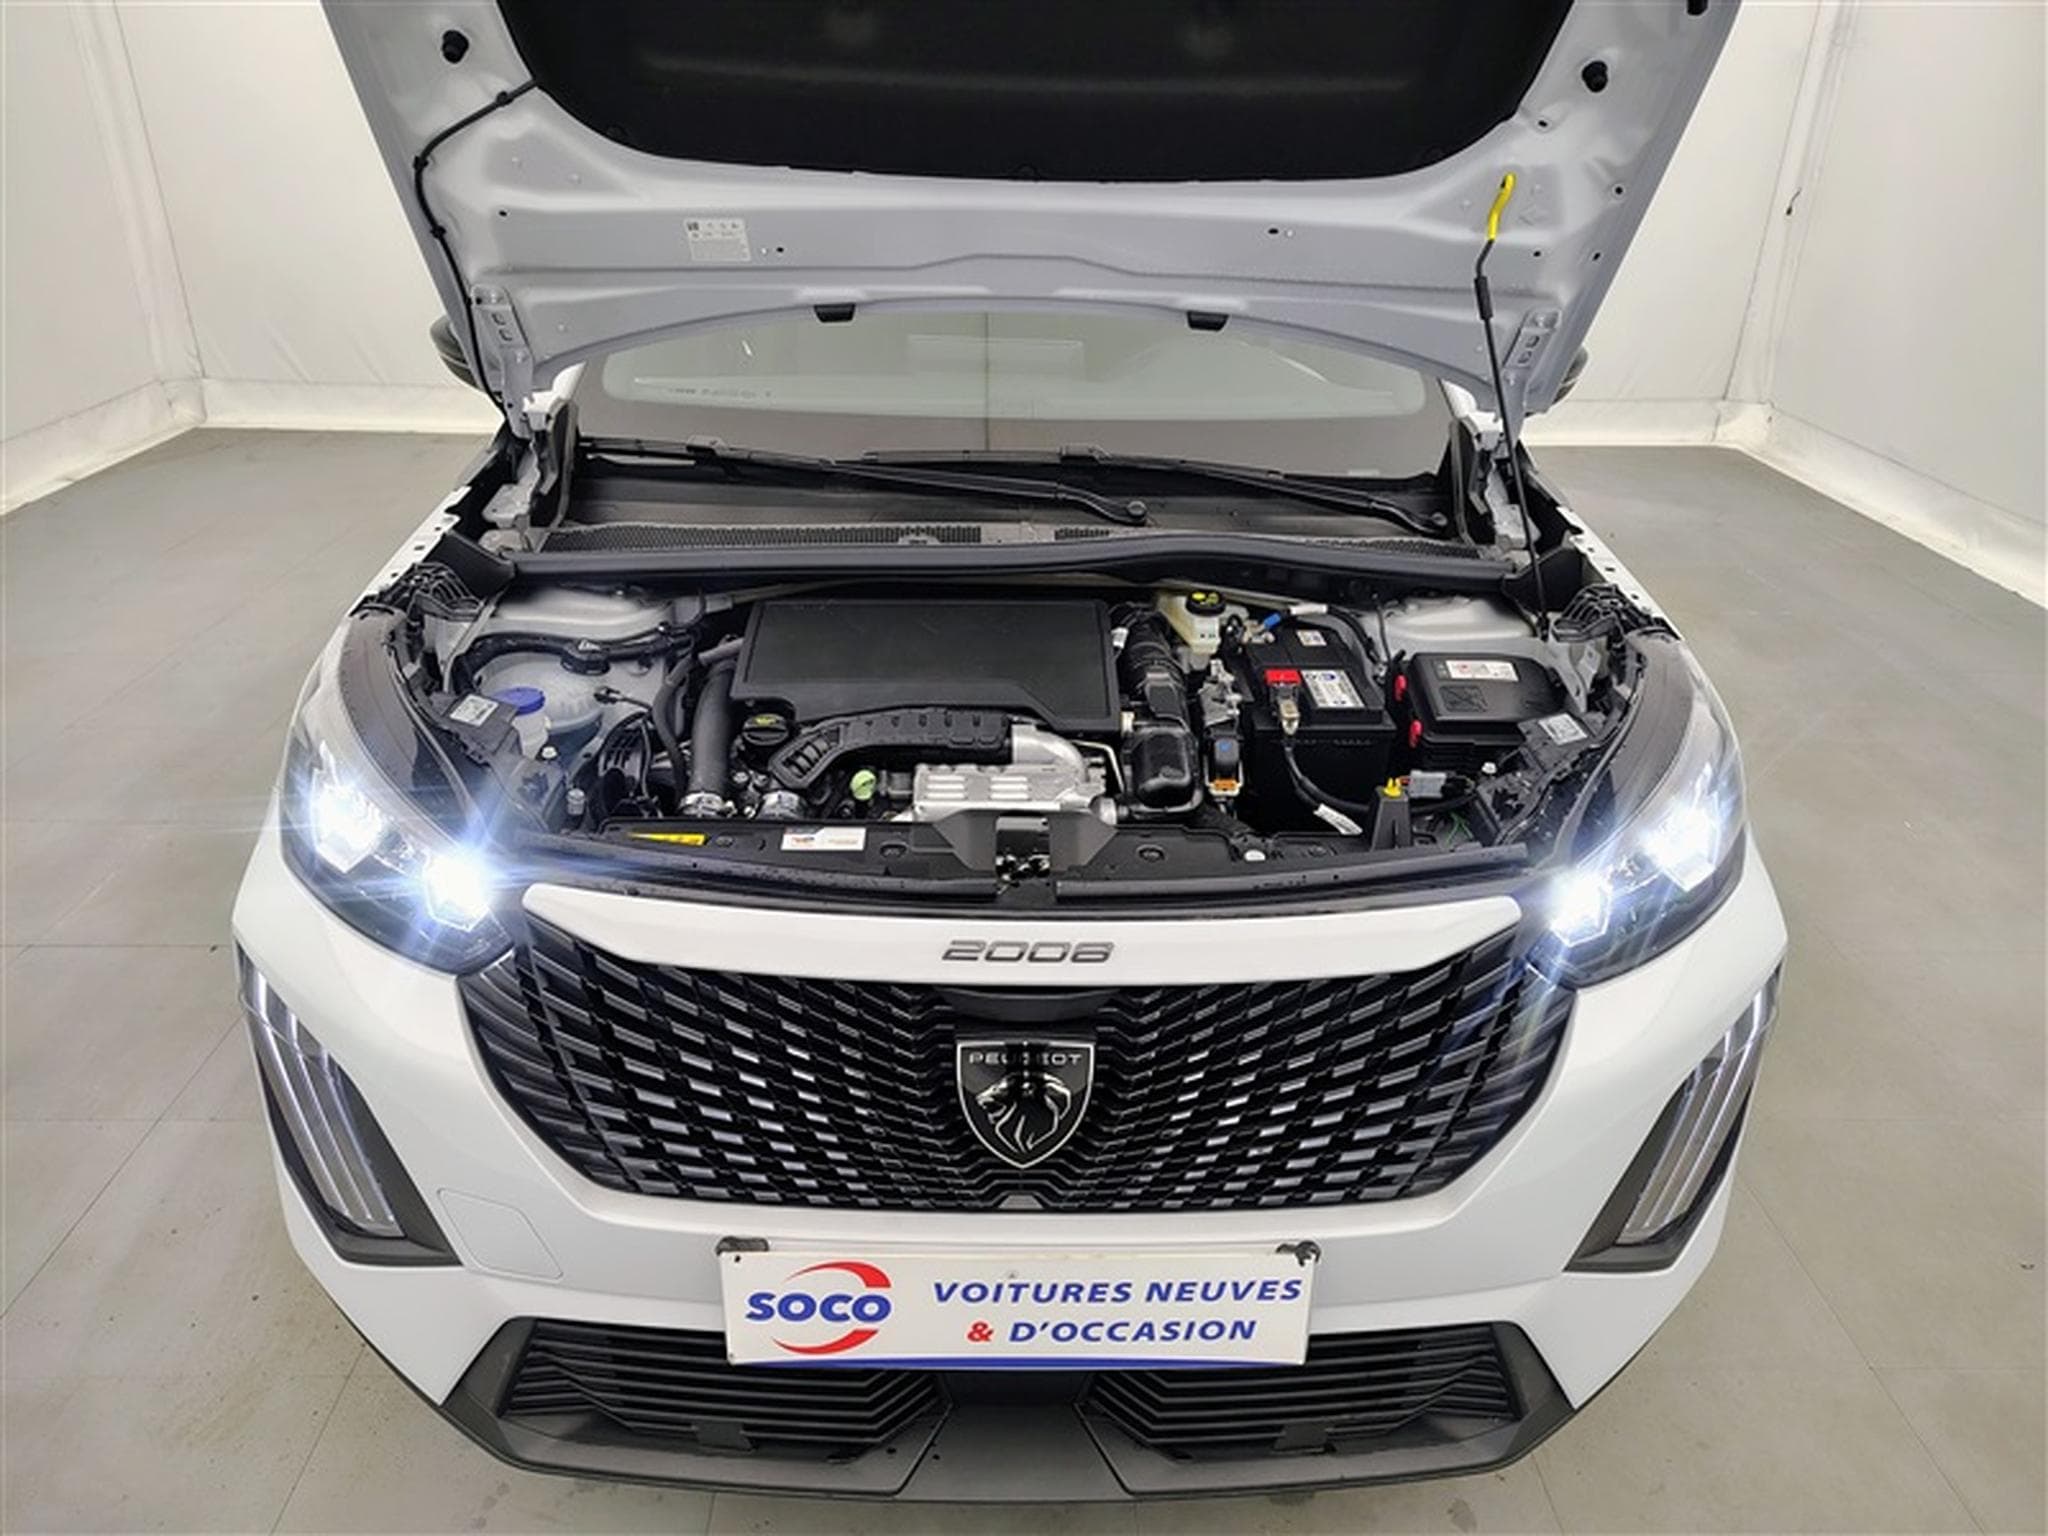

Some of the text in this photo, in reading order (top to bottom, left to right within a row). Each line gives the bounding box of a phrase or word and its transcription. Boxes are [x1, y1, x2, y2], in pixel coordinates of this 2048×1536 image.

[941, 940, 1115, 963] 2008
[969, 1051, 1082, 1065] PEUEOT
[934, 1280, 1302, 1304] VOITURES NEUVES
[745, 1292, 892, 1322] SOCO
[967, 1320, 1257, 1343] & D'OCCASION
